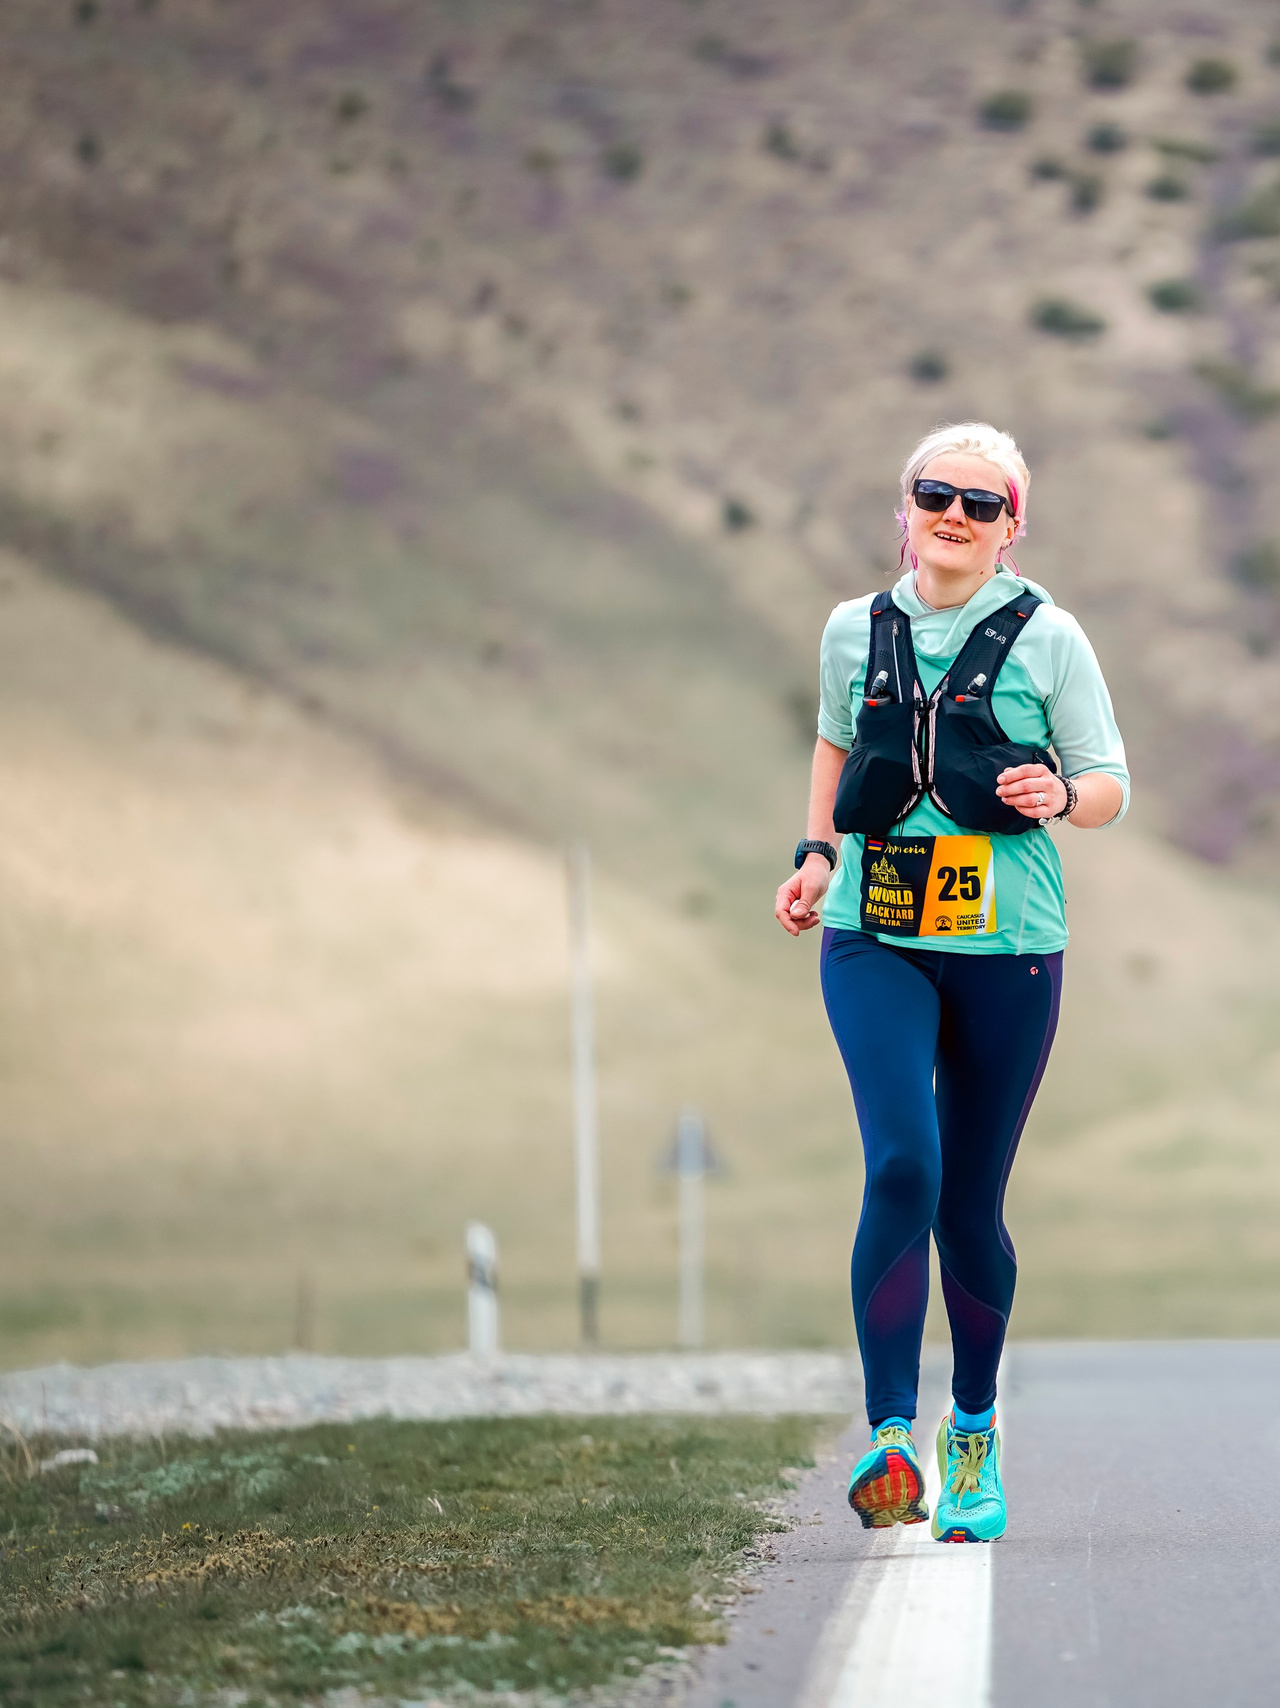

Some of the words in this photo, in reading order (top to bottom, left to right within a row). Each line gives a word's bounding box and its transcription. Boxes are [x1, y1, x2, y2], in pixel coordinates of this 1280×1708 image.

[937, 866, 981, 901] 25
[869, 886, 914, 905] WORLD
[866, 902, 914, 920] BACKYARD
[880, 918, 901, 927] ULTRA
